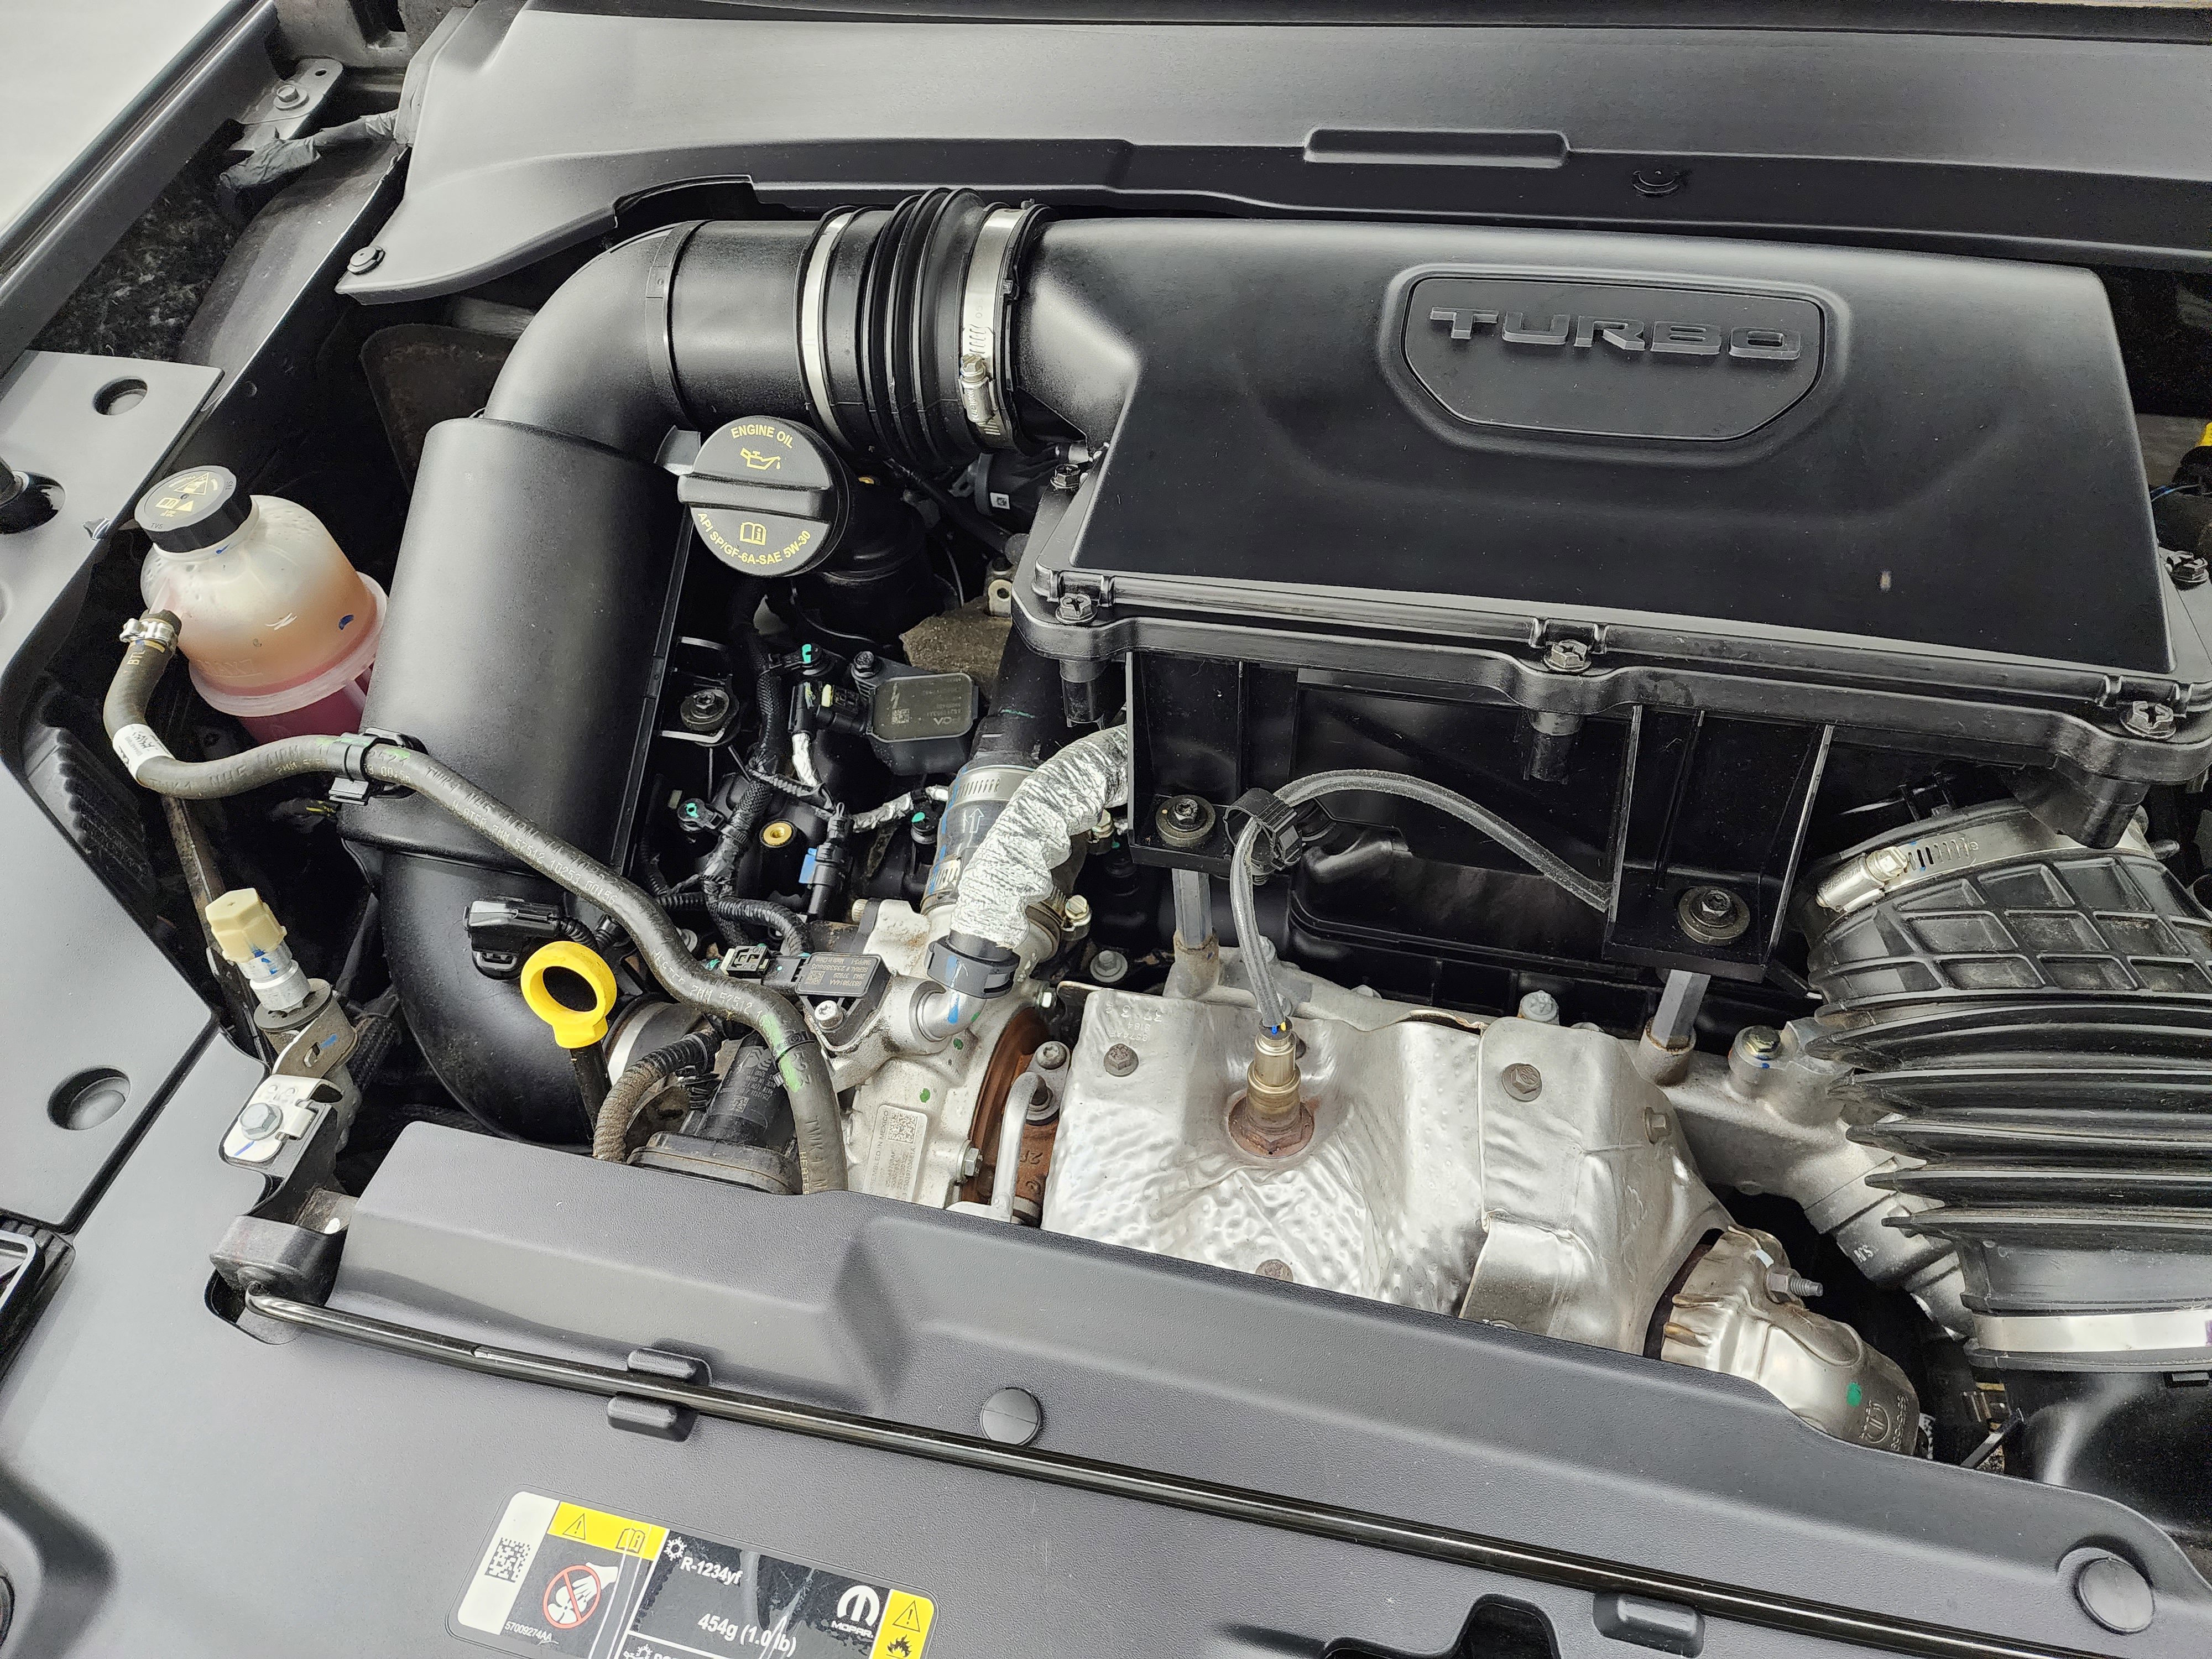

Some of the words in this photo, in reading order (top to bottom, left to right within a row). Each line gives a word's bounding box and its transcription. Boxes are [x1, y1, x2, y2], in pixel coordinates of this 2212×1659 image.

[1430, 306, 1802, 361] TURBO
[730, 424, 775, 440] ENGINE
[776, 430, 795, 449] OIL
[697, 512, 712, 534] API
[709, 530, 783, 566] SP/GF-6A-SAE
[782, 530, 811, 559] 5W-30
[127, 650, 146, 665] BTL
[515, 837, 545, 864] 57512
[877, 1141, 883, 1150] IN
[880, 1110, 889, 1140] MEXICO
[680, 1556, 743, 1586] R-1234yf
[504, 1620, 552, 1642] 57009274AA
[697, 1613, 739, 1642] 454g
